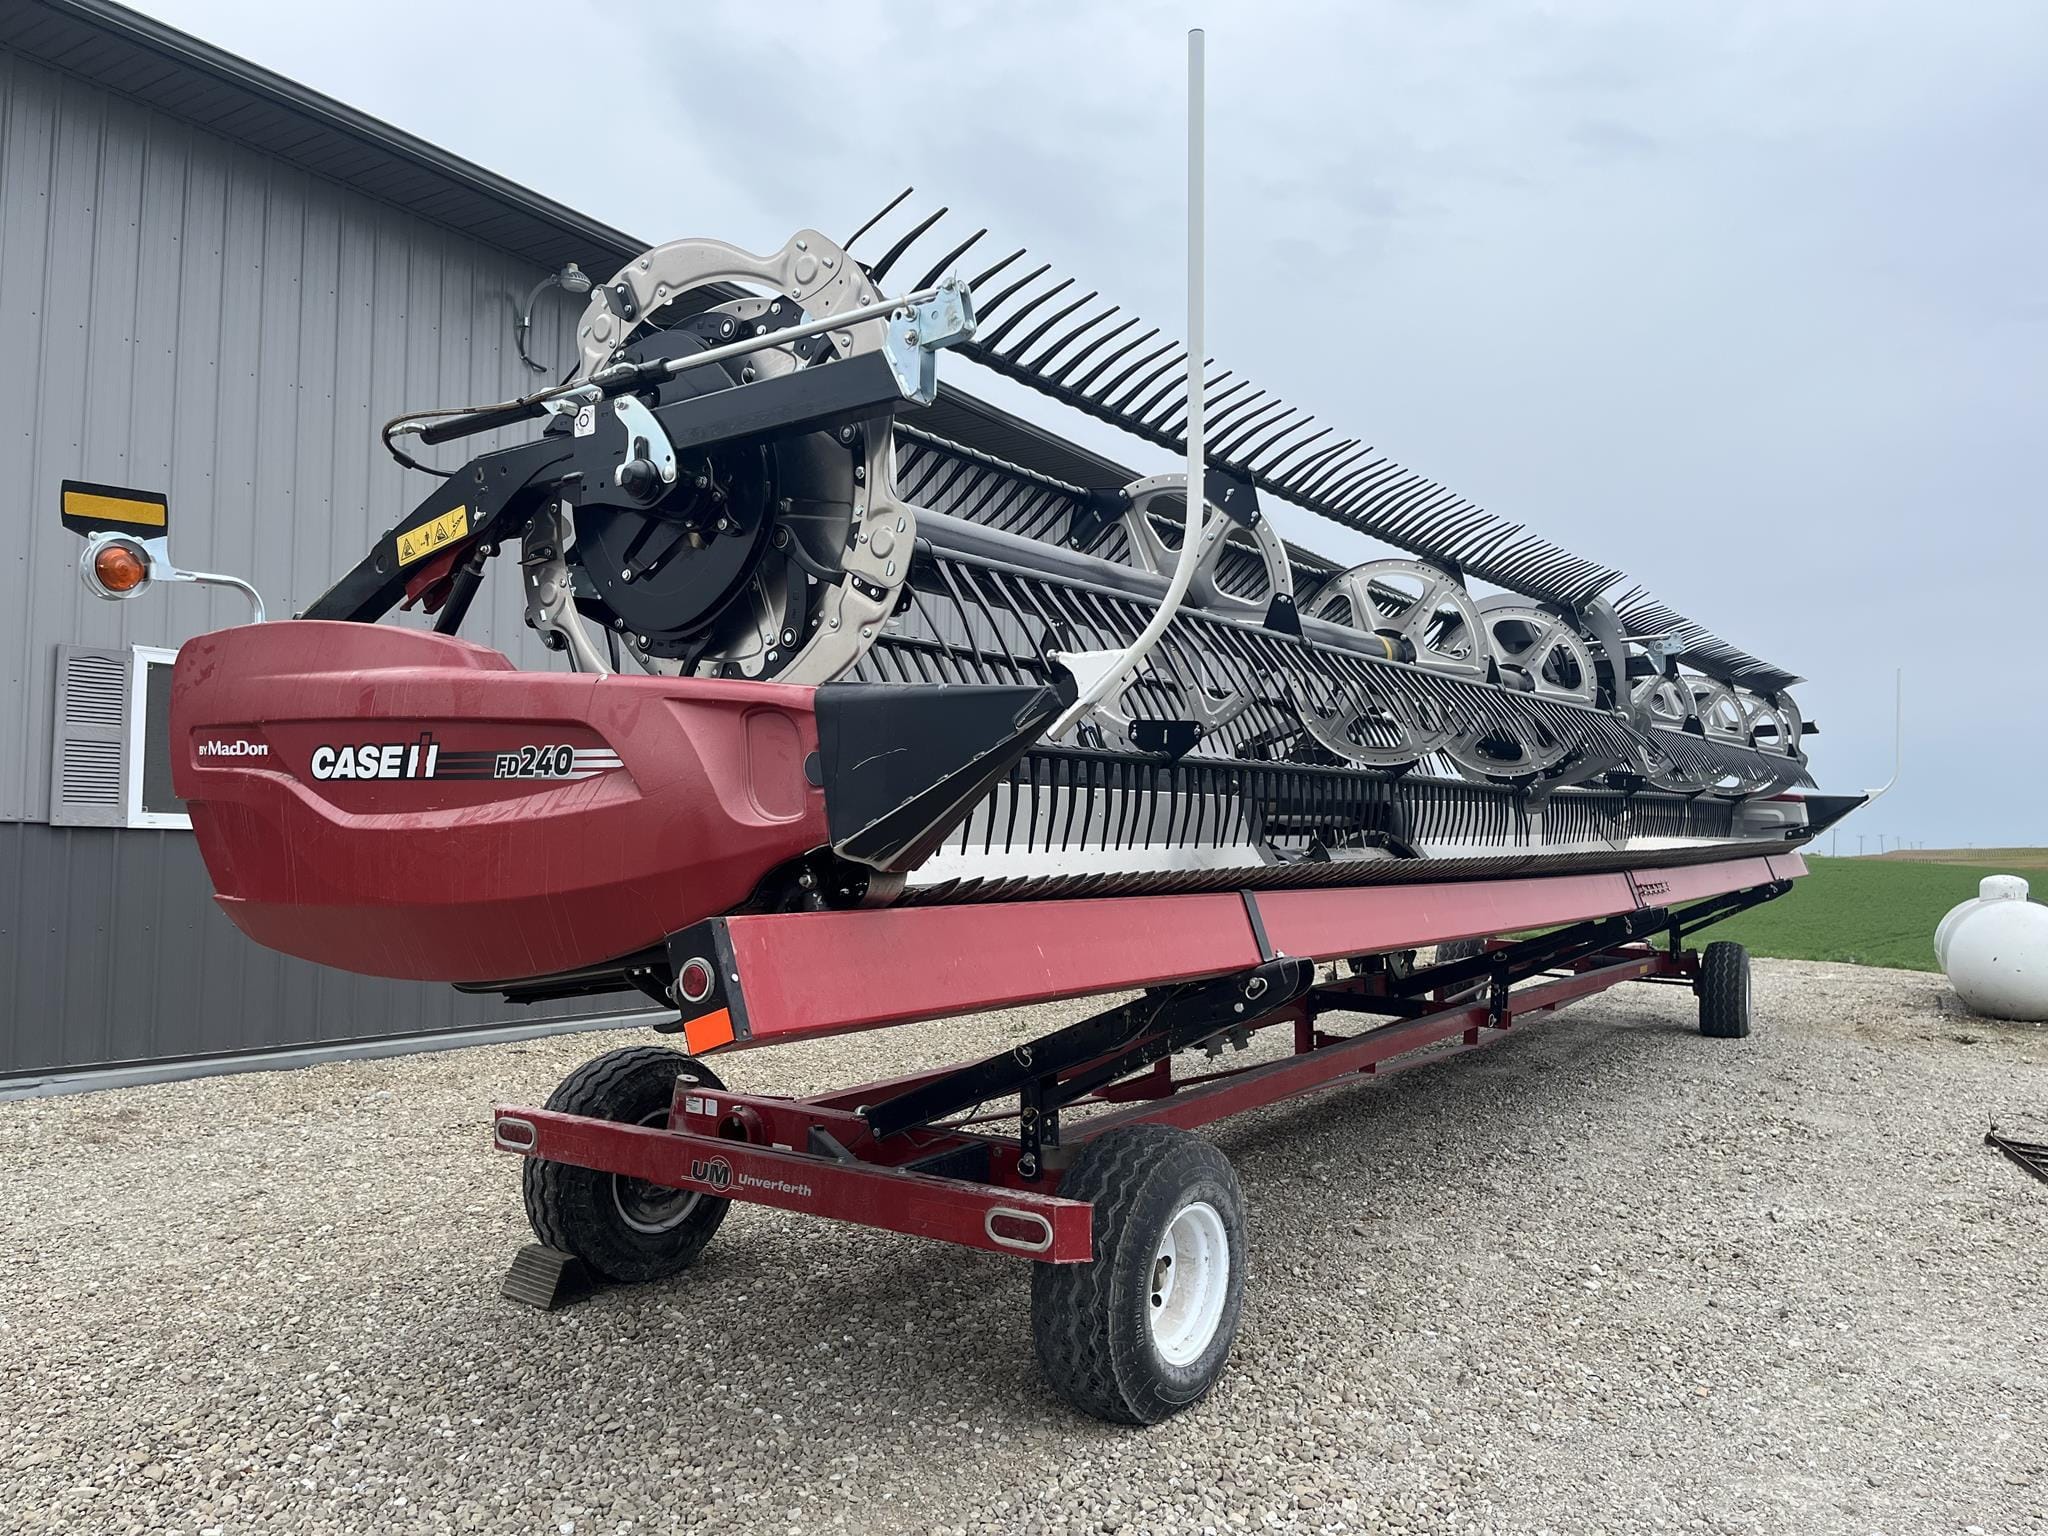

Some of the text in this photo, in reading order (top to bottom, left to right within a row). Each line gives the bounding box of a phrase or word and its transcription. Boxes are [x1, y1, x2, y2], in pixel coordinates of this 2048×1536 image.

[199, 740, 268, 756] BY MacDon
[311, 745, 404, 779] CASE
[494, 745, 574, 778] FD240
[691, 1159, 812, 1197] UM Unverferth
